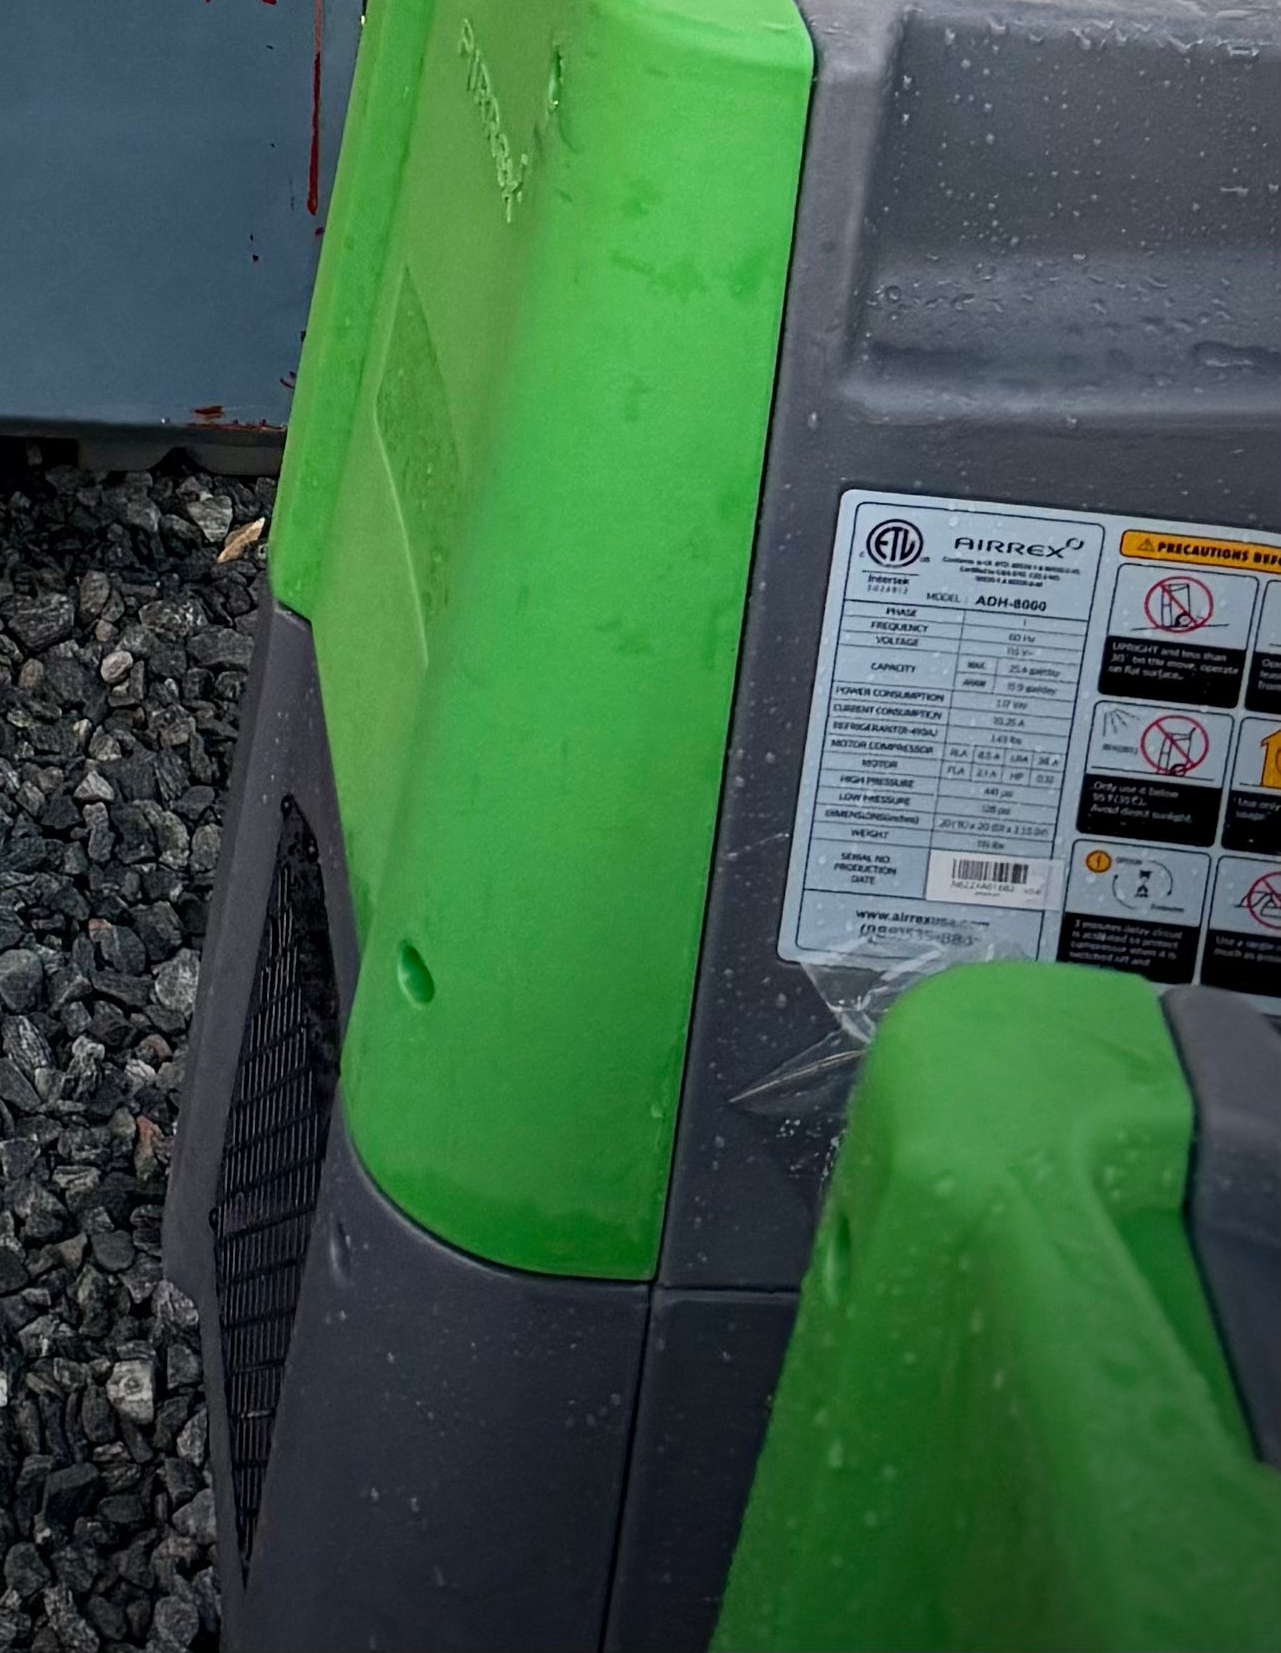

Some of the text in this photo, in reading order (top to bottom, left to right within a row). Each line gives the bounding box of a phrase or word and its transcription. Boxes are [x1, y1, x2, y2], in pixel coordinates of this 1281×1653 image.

[953, 536, 1071, 559] AIRREX
[1157, 541, 1248, 563] PRECAUTIONS
[975, 595, 1047, 612] ADH-8000
[886, 607, 918, 617] PHASE
[871, 621, 929, 633] FREQUENCY
[875, 636, 919, 647] VOLTAGE
[870, 662, 916, 673] CAPACITY
[835, 685, 871, 697] POWER
[873, 689, 945, 703] CONSUMPTION
[876, 706, 942, 720] CONSUMPTION
[831, 739, 934, 754] MOTOR COMPRESSOR
[861, 759, 898, 769] MOTOR
[866, 777, 915, 788] PRESSURE
[851, 829, 889, 839] WEIGHT
[833, 862, 897, 875] PRODUCTION
[851, 874, 876, 884] DATE
